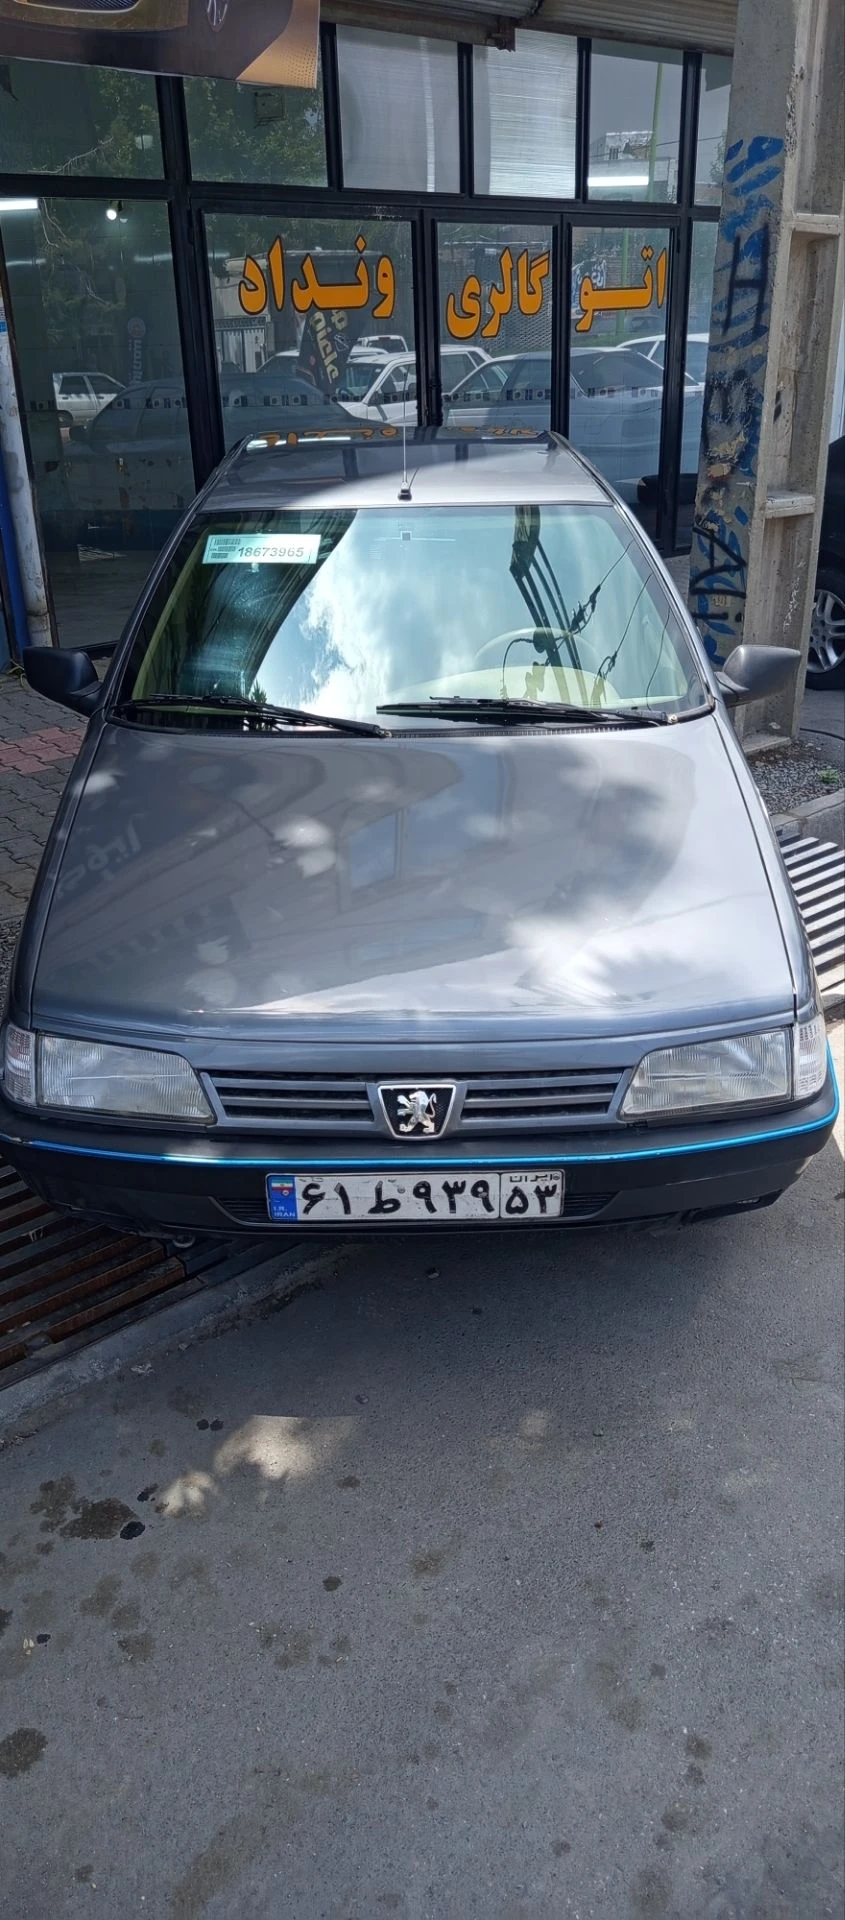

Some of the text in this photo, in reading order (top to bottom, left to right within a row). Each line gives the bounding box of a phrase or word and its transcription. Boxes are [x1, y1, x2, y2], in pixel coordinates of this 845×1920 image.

[237, 234, 396, 319] ونداد
[446, 246, 551, 340] گالری
[574, 244, 668, 333] اتو
[238, 547, 304, 558] 18673965
[509, 1173, 553, 1183] ایران
